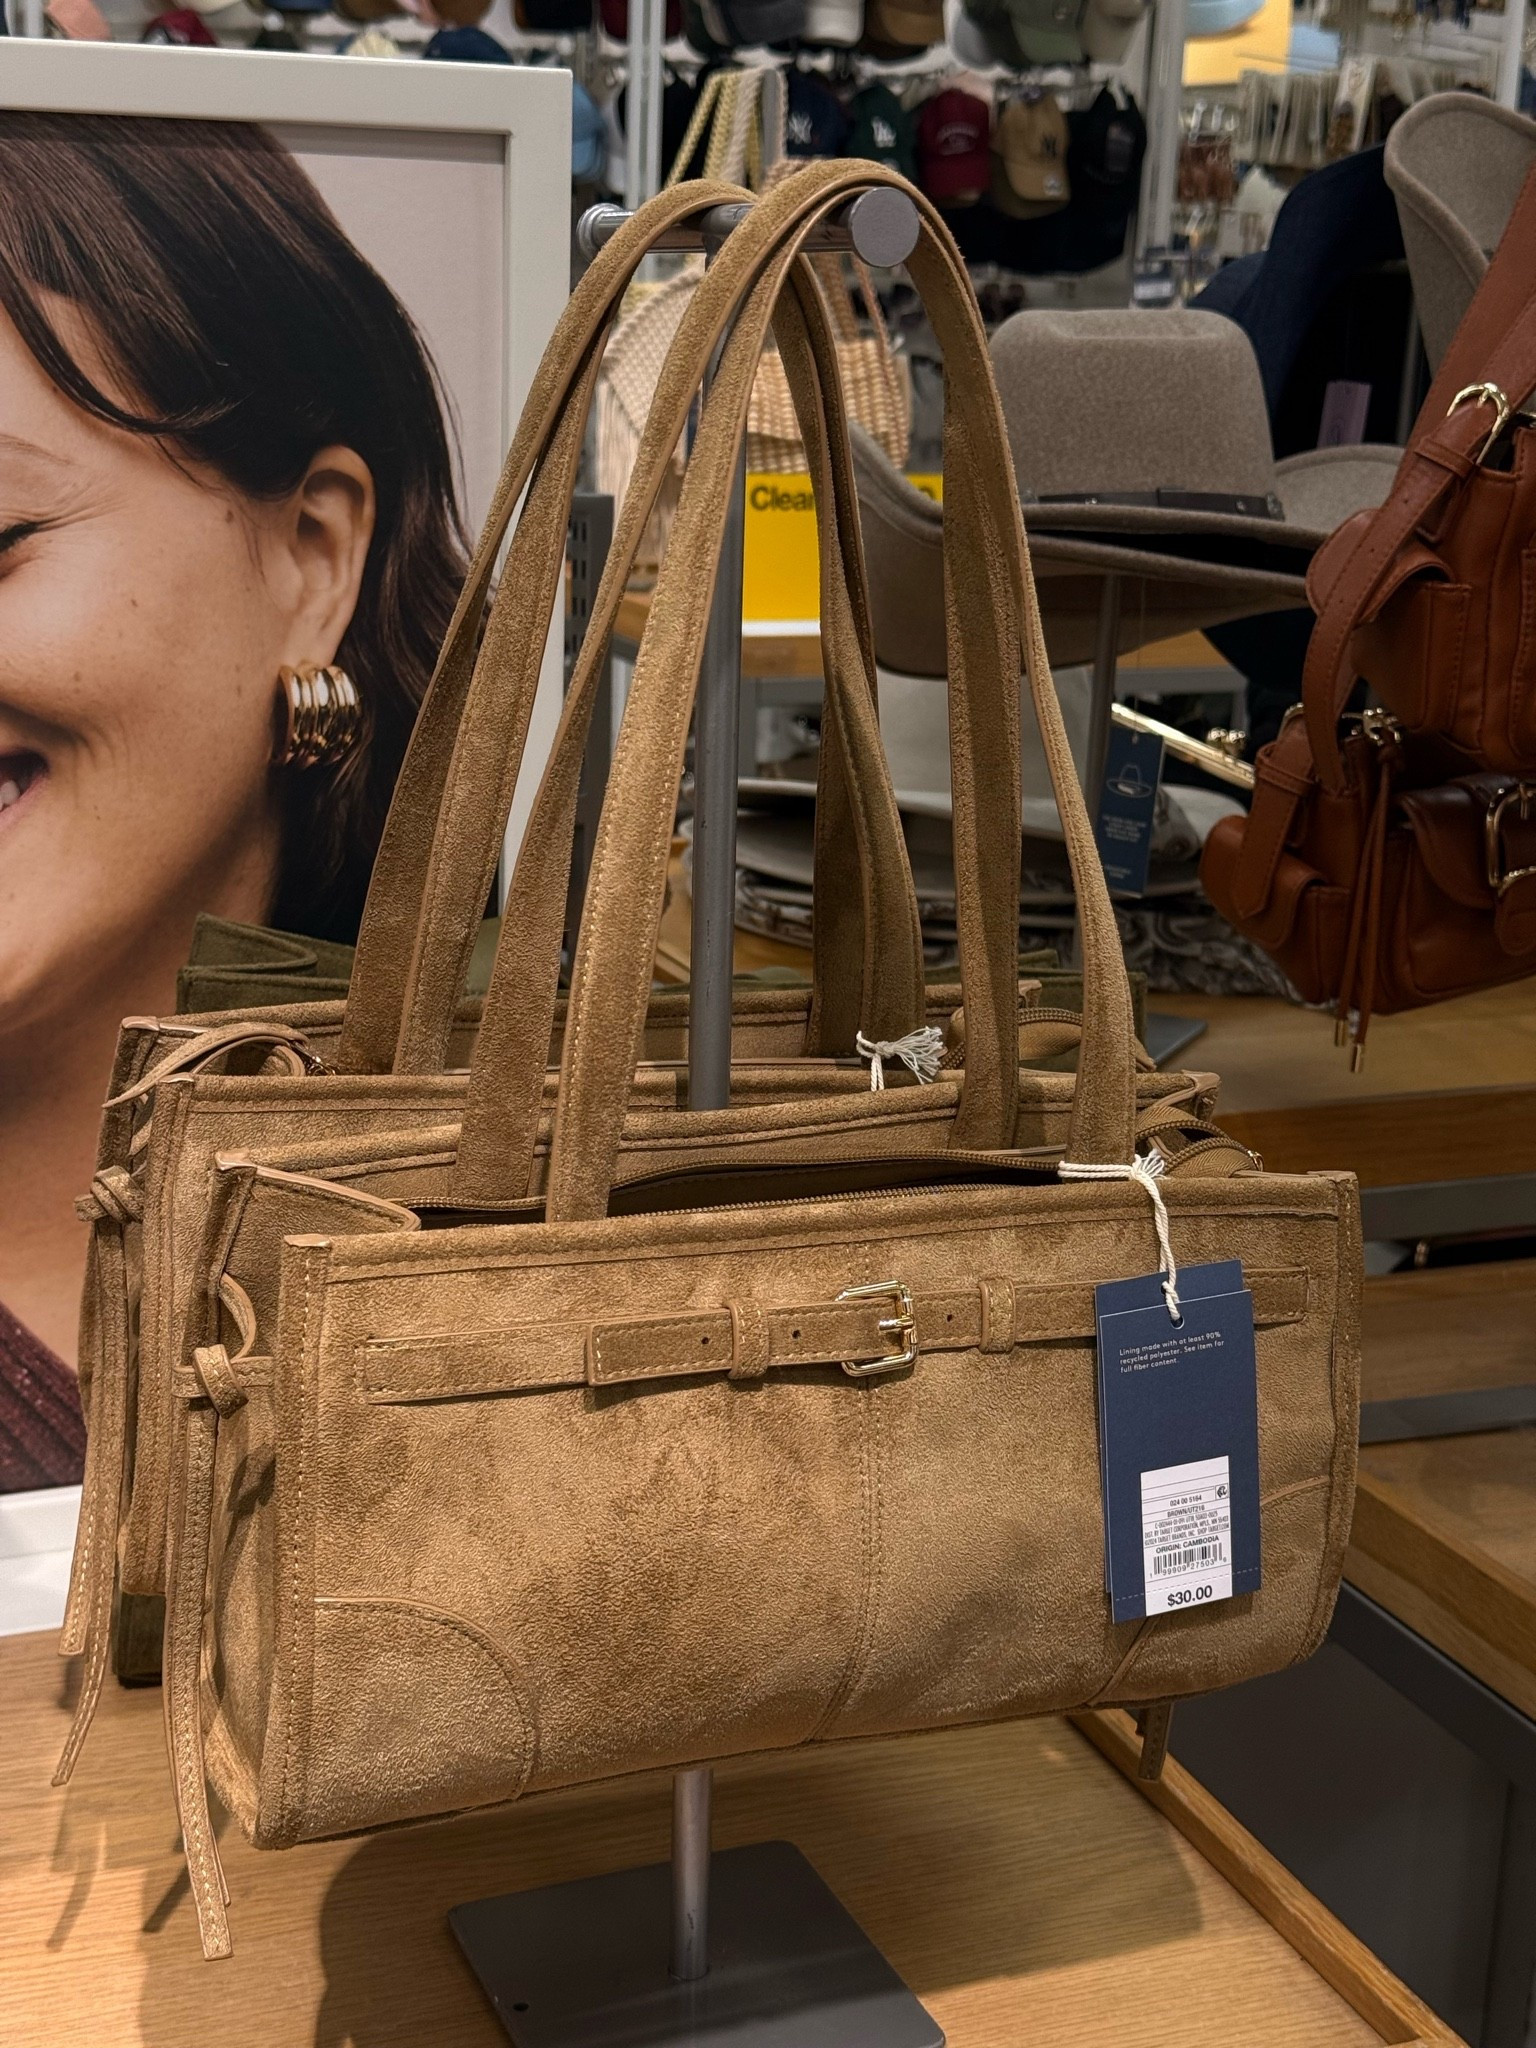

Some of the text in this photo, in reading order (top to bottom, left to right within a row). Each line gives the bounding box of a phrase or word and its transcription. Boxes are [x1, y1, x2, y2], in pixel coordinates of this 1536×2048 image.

[1119, 1347, 1140, 1356] Lining
[1142, 1343, 1160, 1352] made
[1162, 1339, 1177, 1348] with
[1188, 1334, 1205, 1343] least
[1206, 1331, 1221, 1340] 90%
[1120, 1354, 1148, 1364] recycled
[1150, 1349, 1182, 1359] polyester.
[1184, 1345, 1196, 1353] See
[1197, 1342, 1213, 1350] item
[1120, 1358, 1179, 1374] full fiber content.
[1170, 1498, 1180, 1507] 024
[1158, 1534, 1171, 1543] TARGET
[1197, 1527, 1207, 1535] SHOP
[1160, 1525, 1173, 1536] TARGET
[1156, 1536, 1219, 1553] ORIGIN: CAMBODIA
[1162, 1565, 1186, 1575] 99909
[1190, 1559, 1214, 1569] 27503
[1167, 1585, 1212, 1607] $30.00
